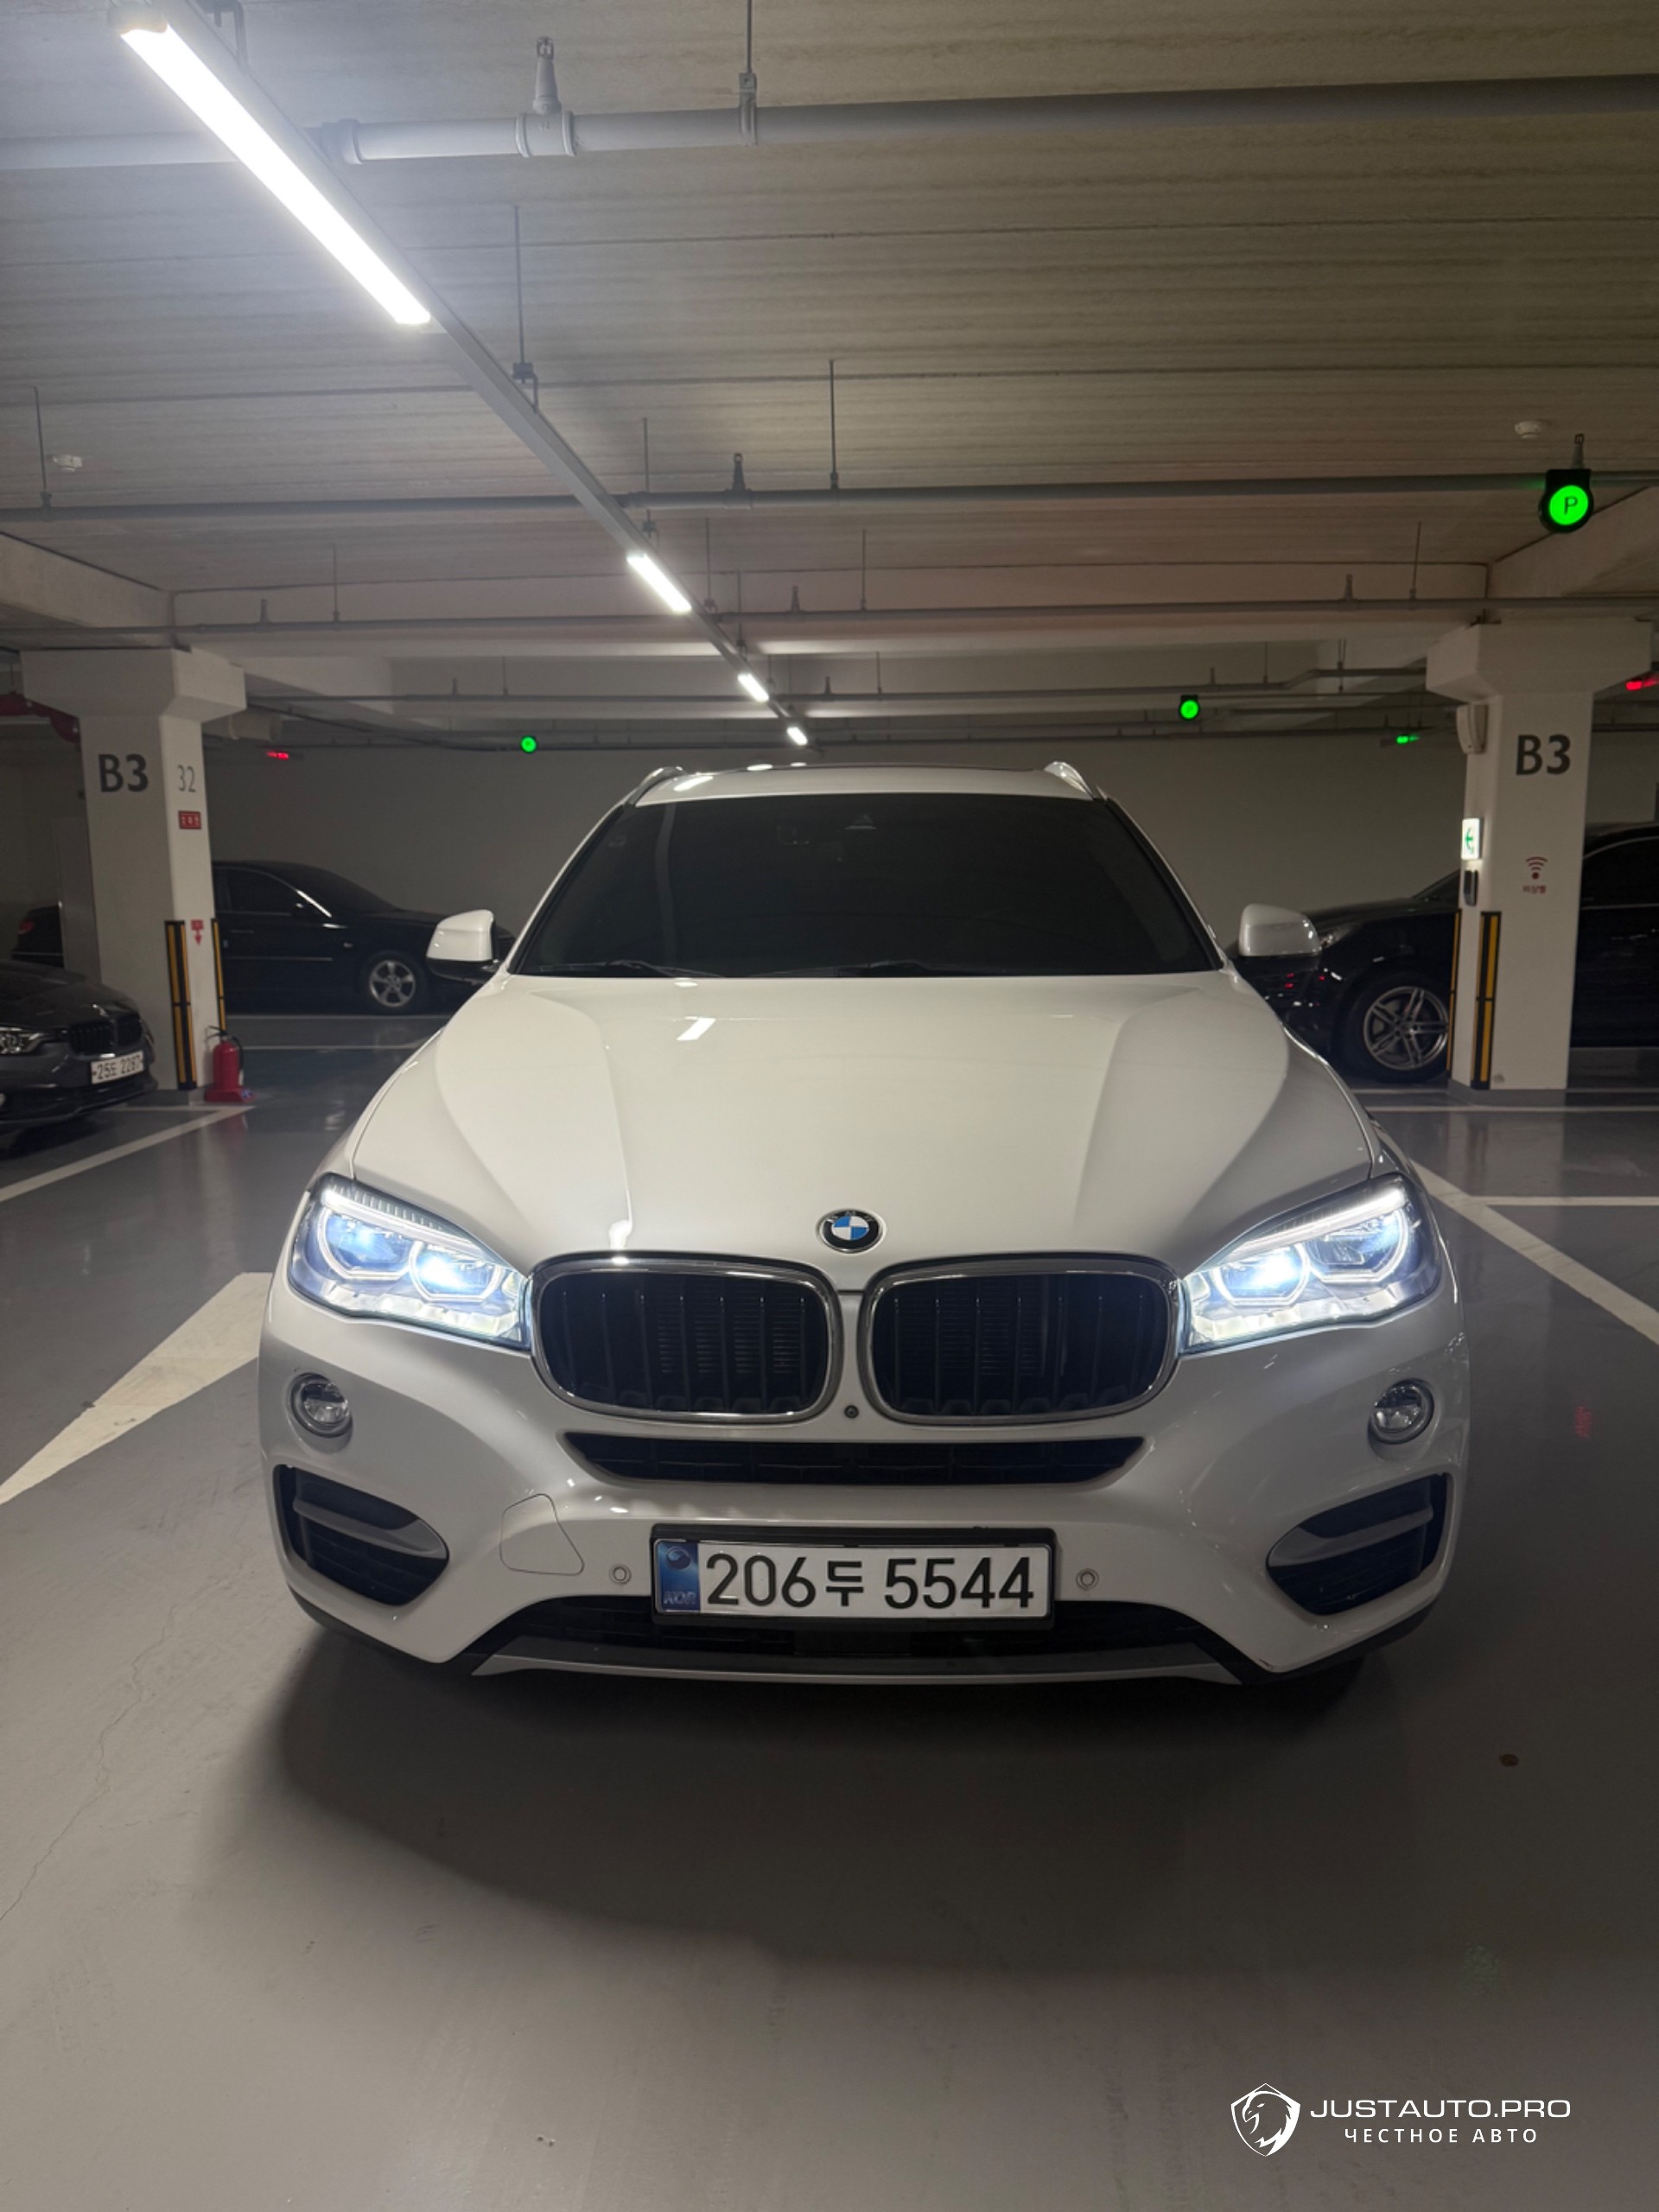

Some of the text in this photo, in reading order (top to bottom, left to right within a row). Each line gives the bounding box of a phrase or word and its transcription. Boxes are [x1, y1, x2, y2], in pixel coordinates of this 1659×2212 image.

[1564, 495, 1579, 516] P
[98, 753, 149, 793] B3
[1516, 734, 1571, 776] B3
[177, 764, 196, 793] 32
[707, 1553, 1034, 1610] 206두 5544
